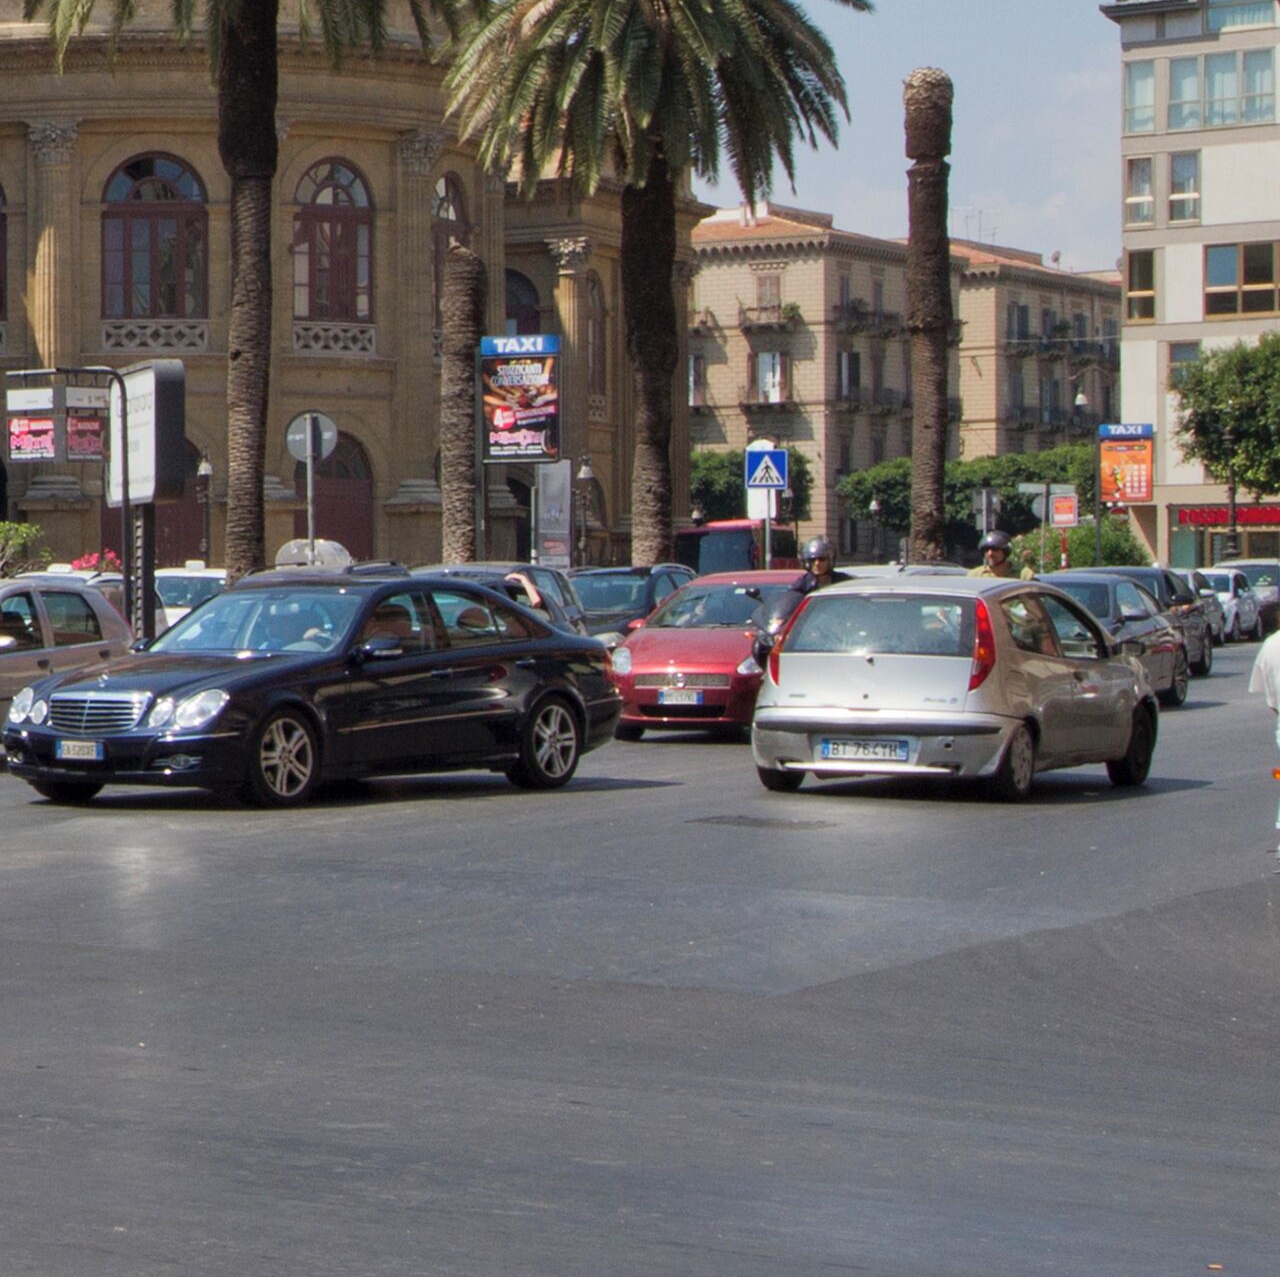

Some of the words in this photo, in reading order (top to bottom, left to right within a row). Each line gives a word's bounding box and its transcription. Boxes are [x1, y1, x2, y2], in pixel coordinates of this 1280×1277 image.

[493, 337, 544, 353] TAXI
[1108, 425, 1143, 435] TAXI
[831, 741, 848, 757] BT
